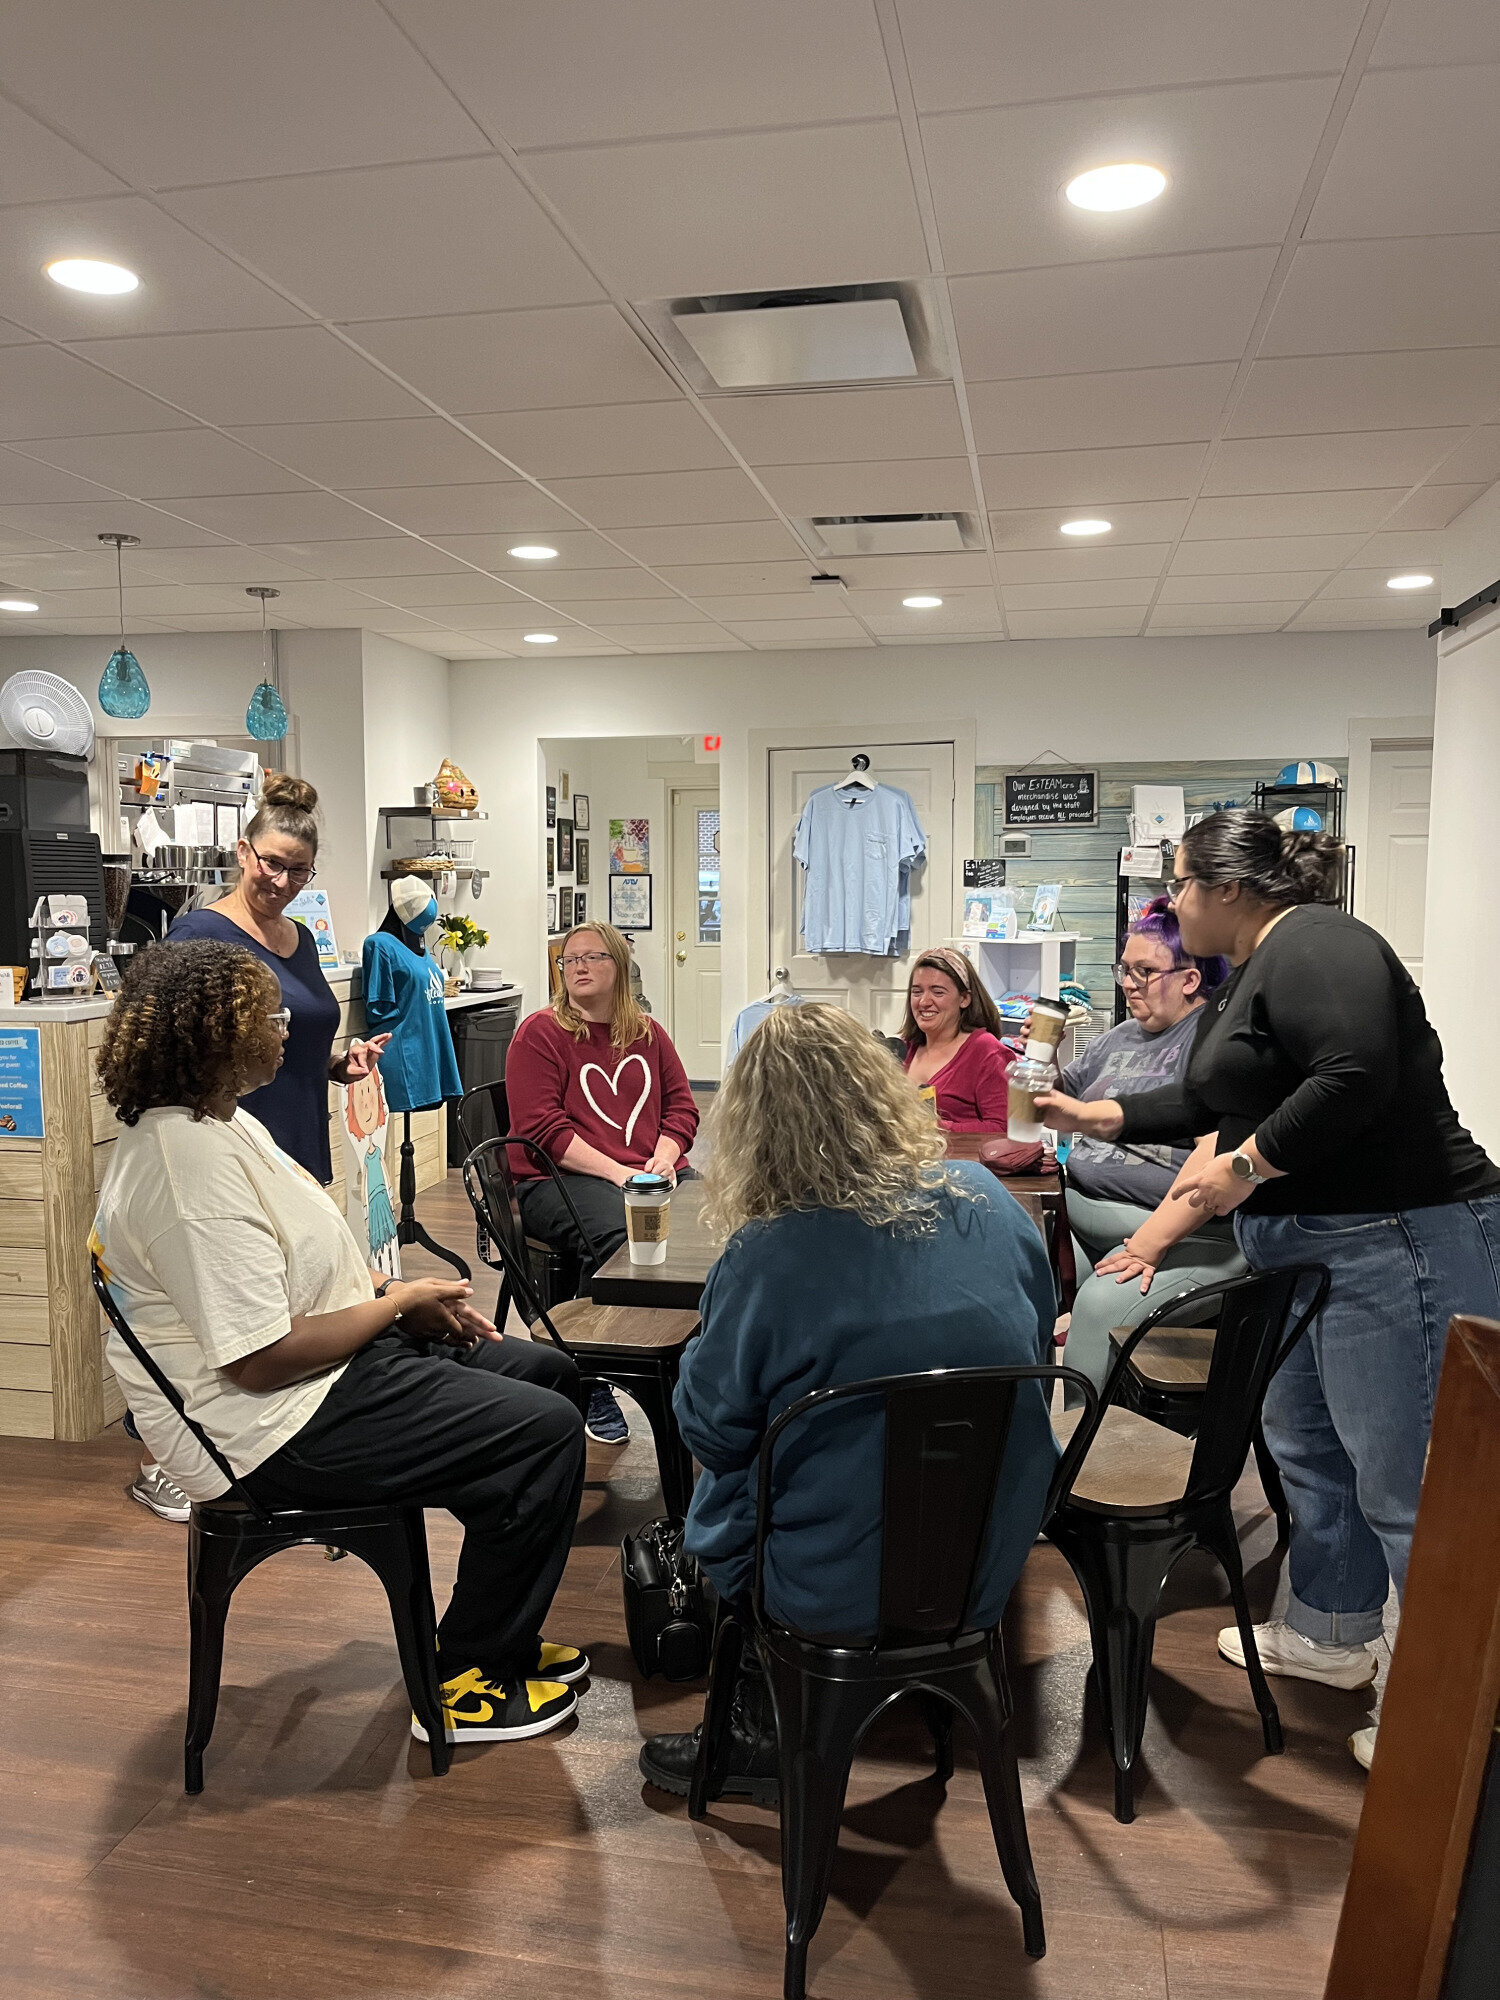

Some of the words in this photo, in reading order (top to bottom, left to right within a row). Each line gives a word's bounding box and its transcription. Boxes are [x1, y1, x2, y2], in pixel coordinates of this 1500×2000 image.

[1012, 780, 1026, 792] Our
[1017, 792, 1059, 801] merchandise
[1062, 792, 1078, 801] was
[1011, 802, 1040, 814] designed
[1042, 803, 1051, 812] by
[1064, 801, 1081, 809] staff
[1057, 812, 1067, 820] ALL
